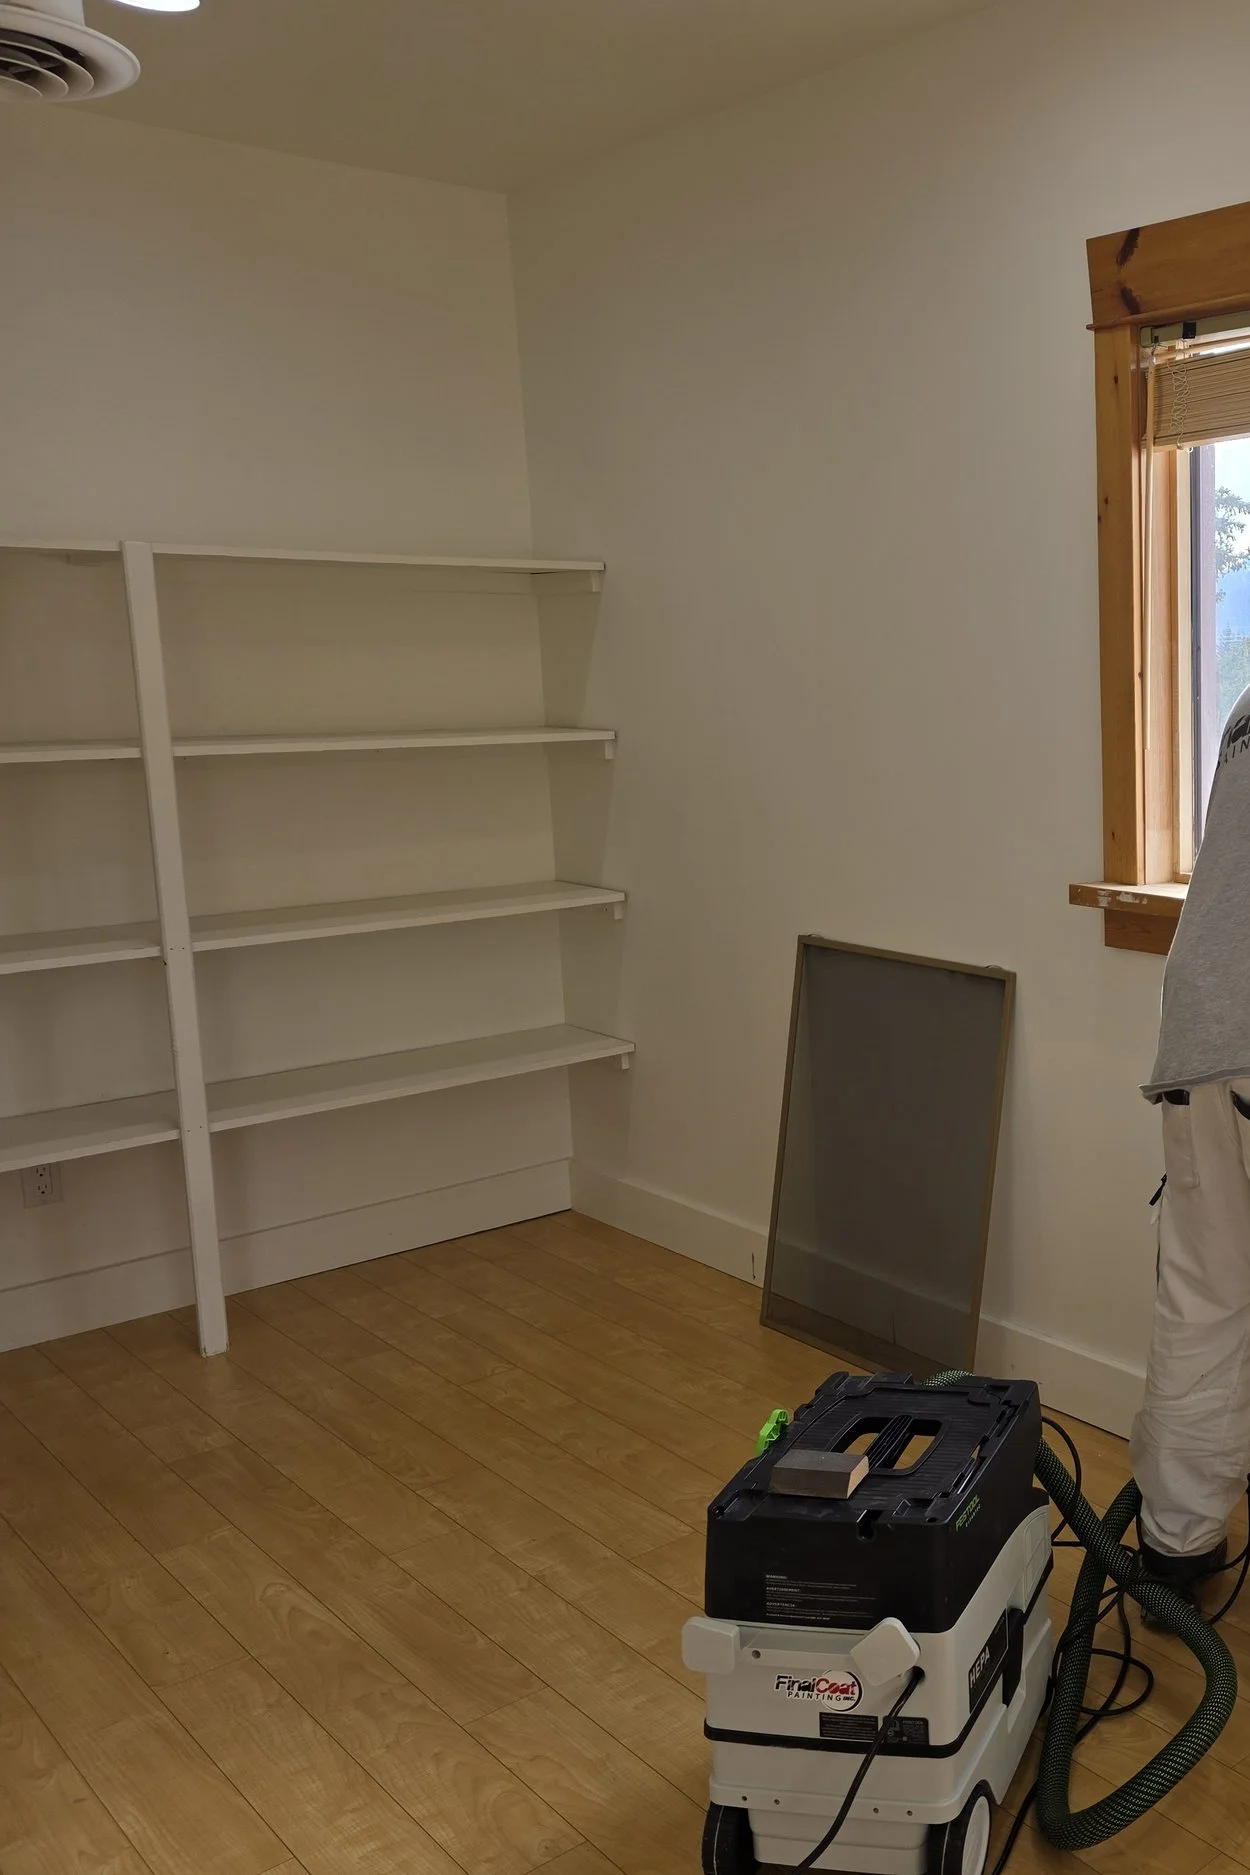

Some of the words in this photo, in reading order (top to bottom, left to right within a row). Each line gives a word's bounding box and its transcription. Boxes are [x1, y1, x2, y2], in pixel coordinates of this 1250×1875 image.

[955, 1494, 980, 1532] FESTOOL
[970, 1646, 990, 1689] HEPA
[787, 1691, 841, 1702] PAINTING
